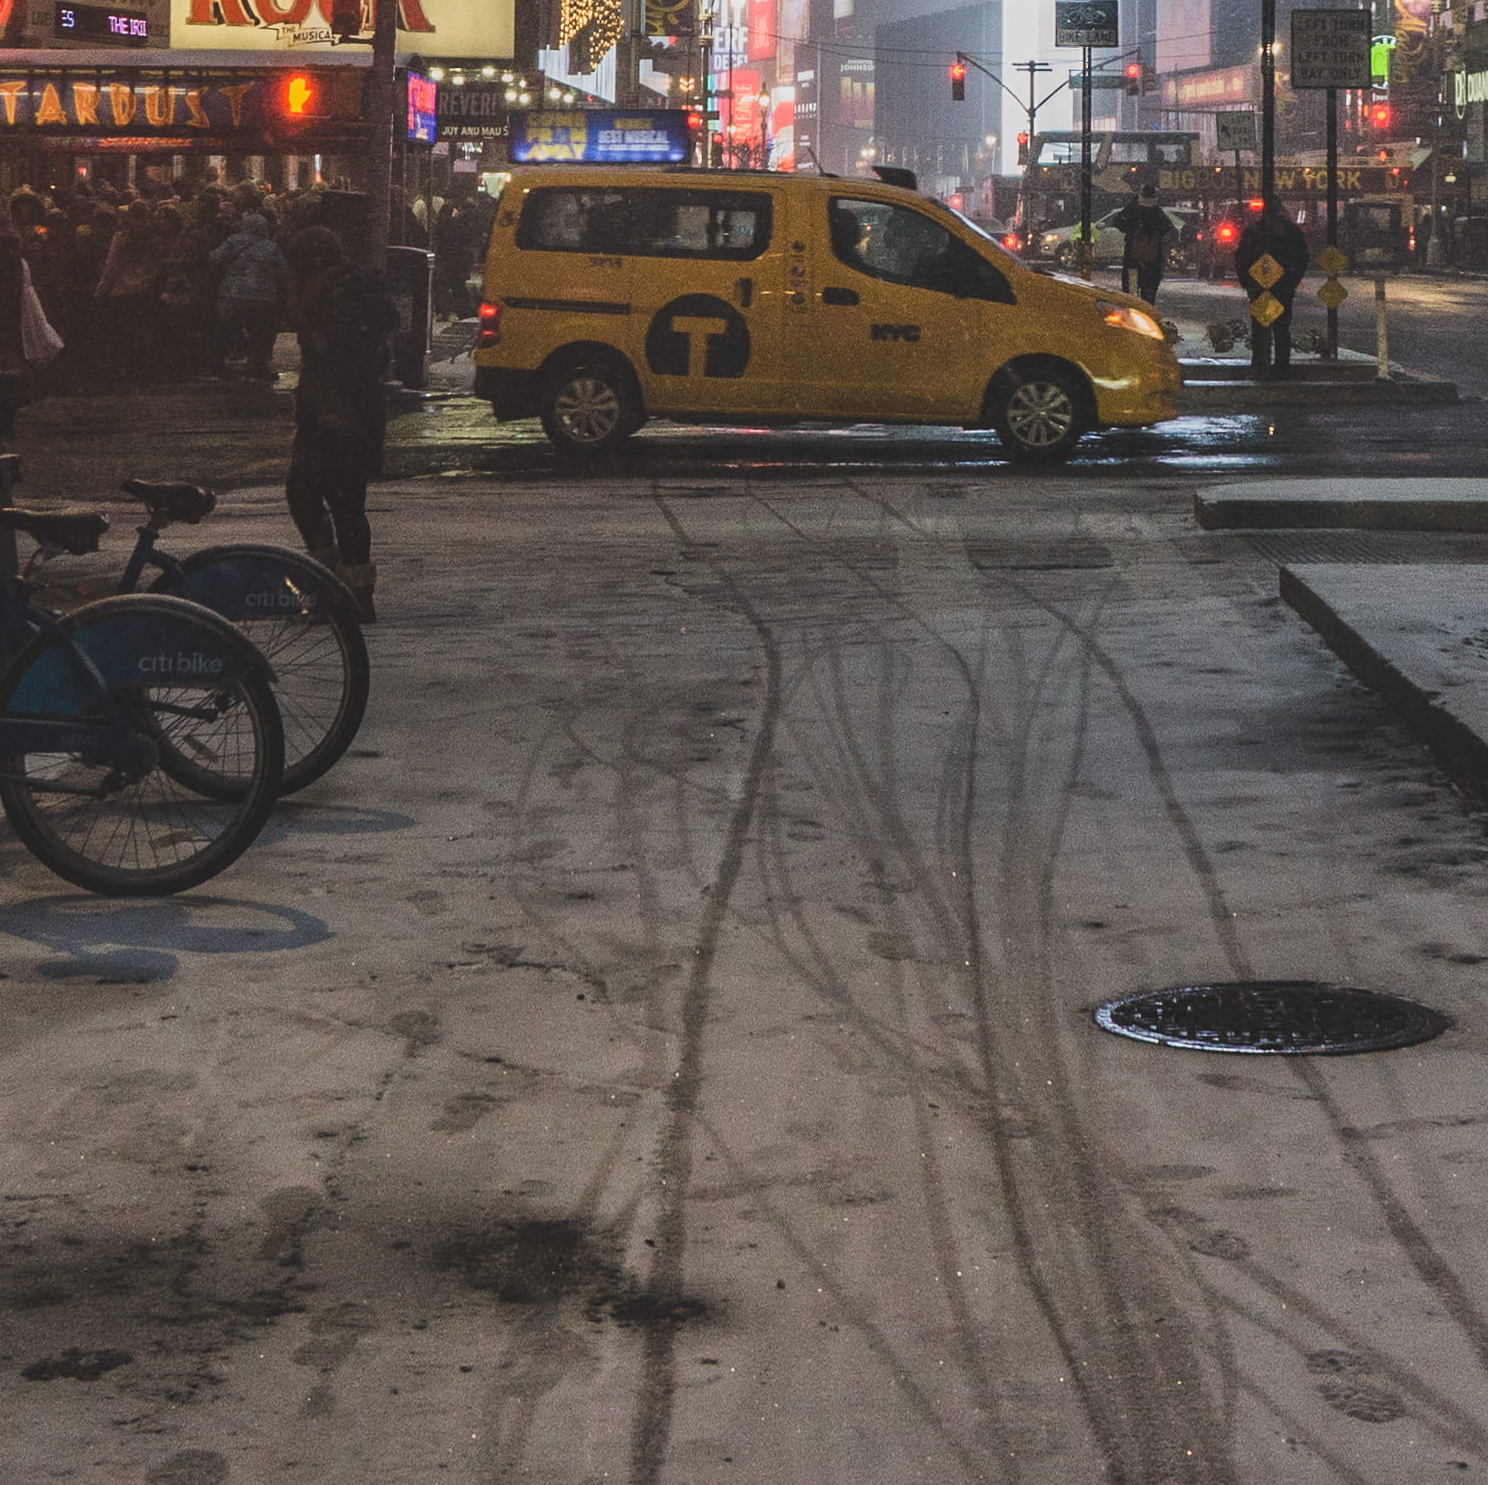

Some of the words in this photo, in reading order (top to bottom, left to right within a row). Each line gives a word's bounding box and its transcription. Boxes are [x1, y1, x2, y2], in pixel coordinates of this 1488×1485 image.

[280, 24, 298, 38] THE
[1159, 170, 1196, 190] BIG
[1243, 170, 1295, 190] NW
[1303, 170, 1362, 190] YORK
[871, 324, 922, 342] NYC
[138, 654, 173, 673] citi
[176, 653, 224, 675] bike
